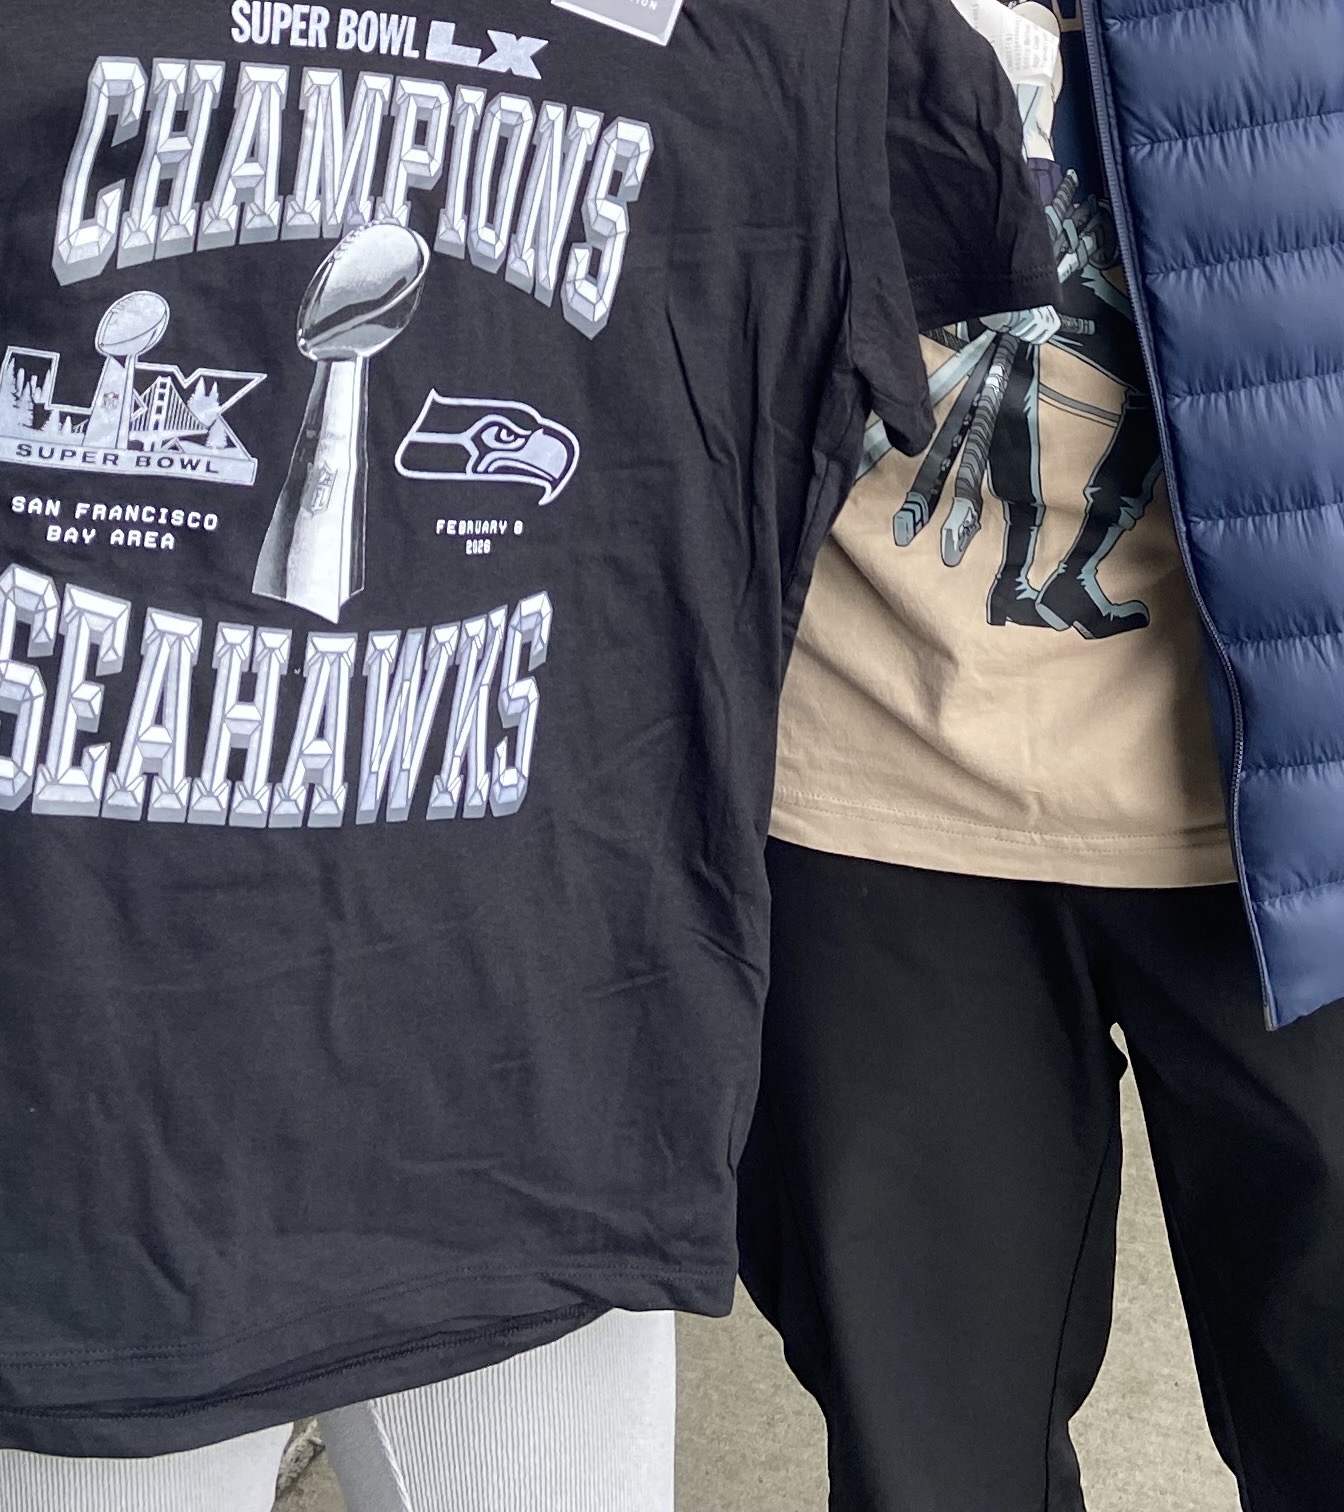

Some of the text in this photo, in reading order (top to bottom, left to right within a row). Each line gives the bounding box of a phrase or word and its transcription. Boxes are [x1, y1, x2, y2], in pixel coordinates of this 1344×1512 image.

[336, 7, 420, 59] BOWL
[425, 20, 549, 80] LX
[52, 55, 654, 341] CHAMPIONS
[16, 442, 221, 475] SUPER BOWL
[11, 495, 218, 531] SAN FRANCISCO
[436, 519, 507, 535] FEBRUARY
[46, 525, 175, 550] BAY AREA
